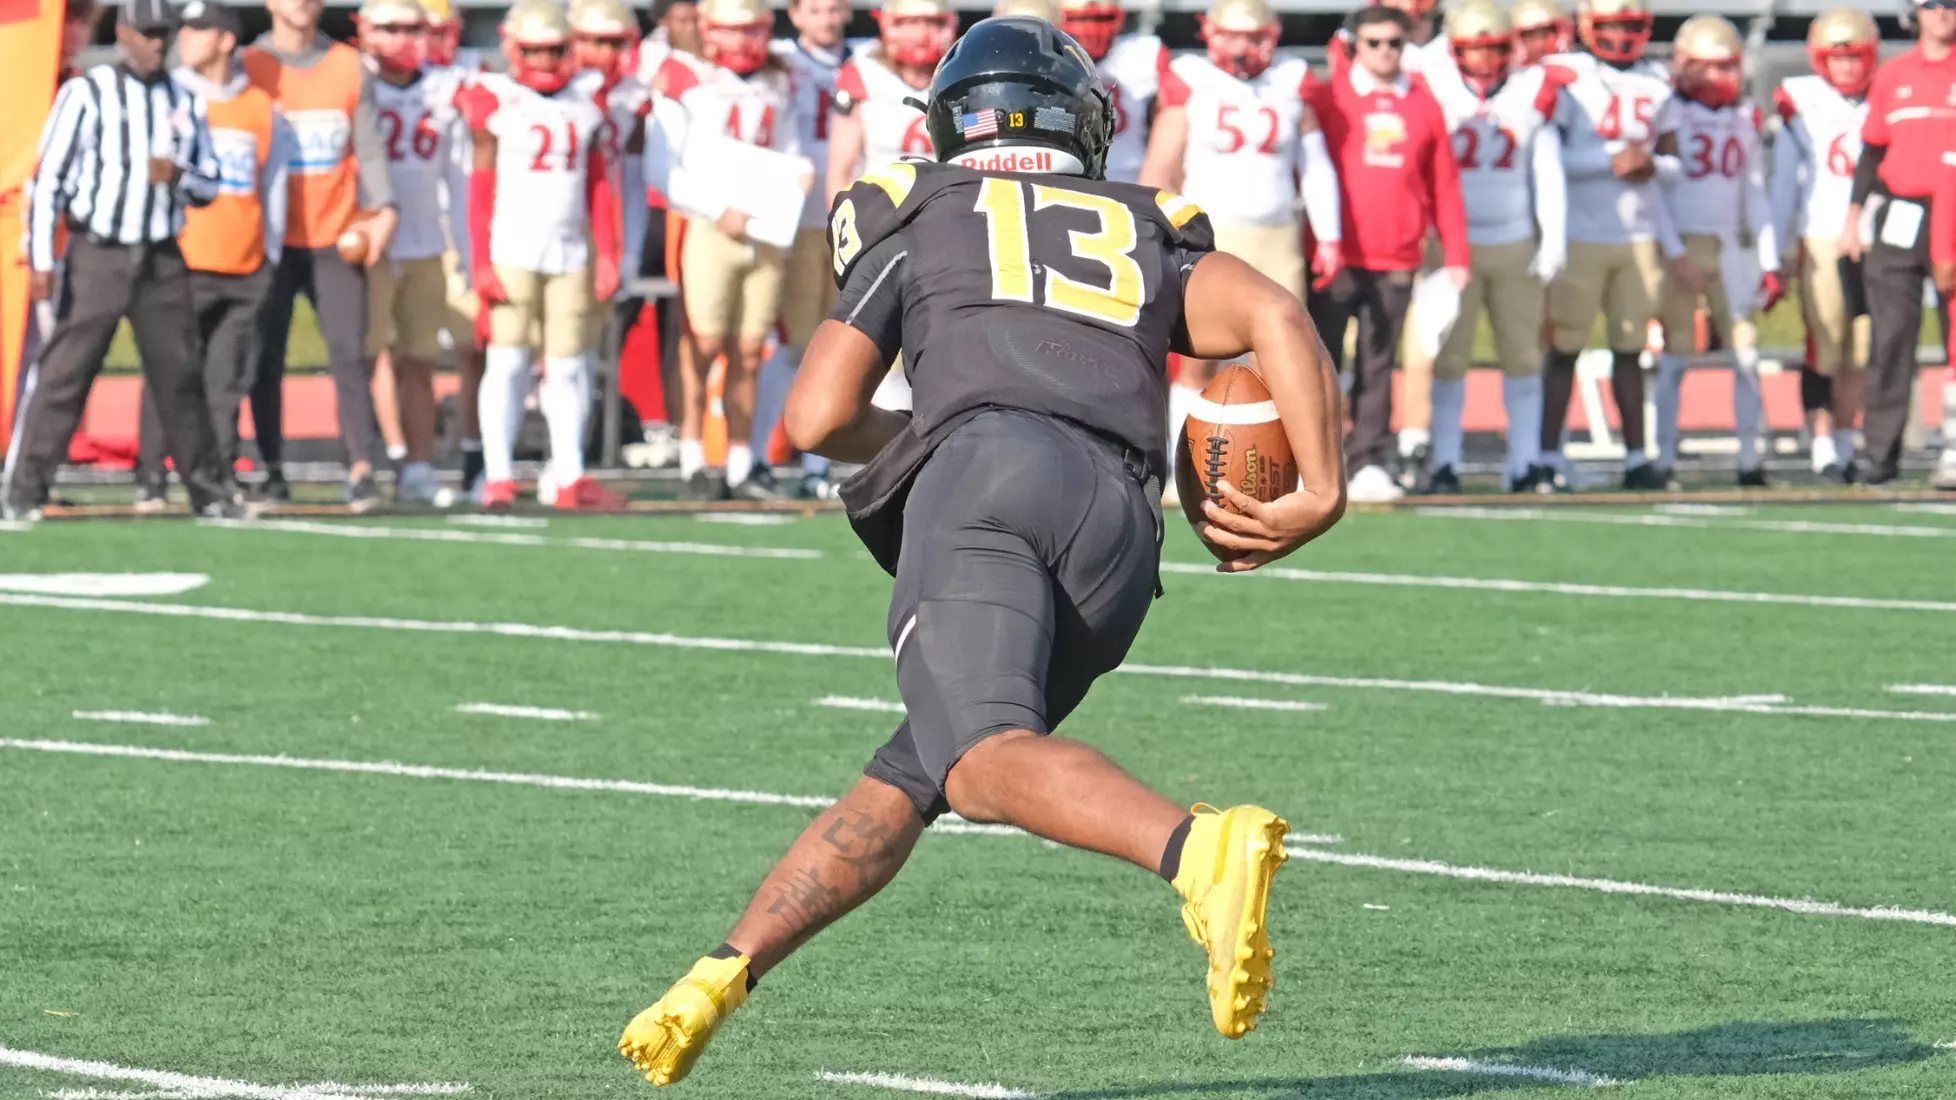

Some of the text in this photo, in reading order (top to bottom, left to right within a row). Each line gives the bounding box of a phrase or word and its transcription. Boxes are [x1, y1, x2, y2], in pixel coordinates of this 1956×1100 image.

[379, 107, 439, 161] 26
[1008, 112, 1024, 128] 13
[1213, 104, 1281, 154] 52
[528, 121, 578, 171] 21
[961, 152, 1052, 172] Riddell
[1456, 127, 1517, 169] 22
[1686, 134, 1746, 179] 30
[973, 176, 1146, 327] 13
